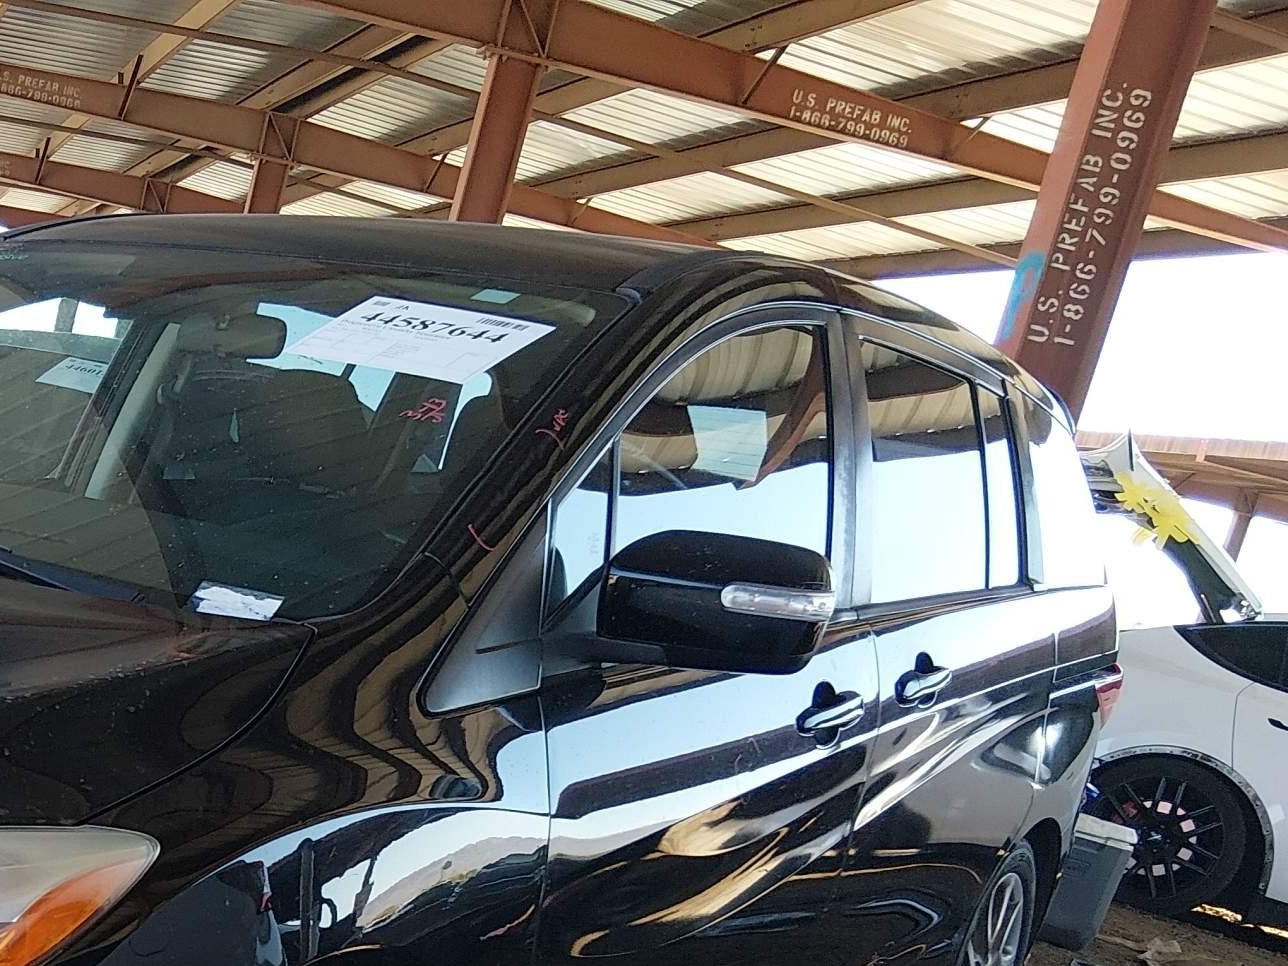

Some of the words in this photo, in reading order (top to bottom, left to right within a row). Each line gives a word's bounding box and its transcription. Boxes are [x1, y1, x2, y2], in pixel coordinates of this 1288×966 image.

[789, 106, 908, 148] 1-866-799-0969
[792, 89, 819, 109] U.S.
[826, 98, 881, 124] PREFAB
[886, 114, 912, 134] INC.
[1027, 289, 1065, 344] U.S.
[1049, 153, 1103, 271] PREFAB
[1091, 82, 1128, 139] INC.
[1053, 88, 1152, 346] 1-866-799-0969
[361, 311, 510, 344] 44587644
